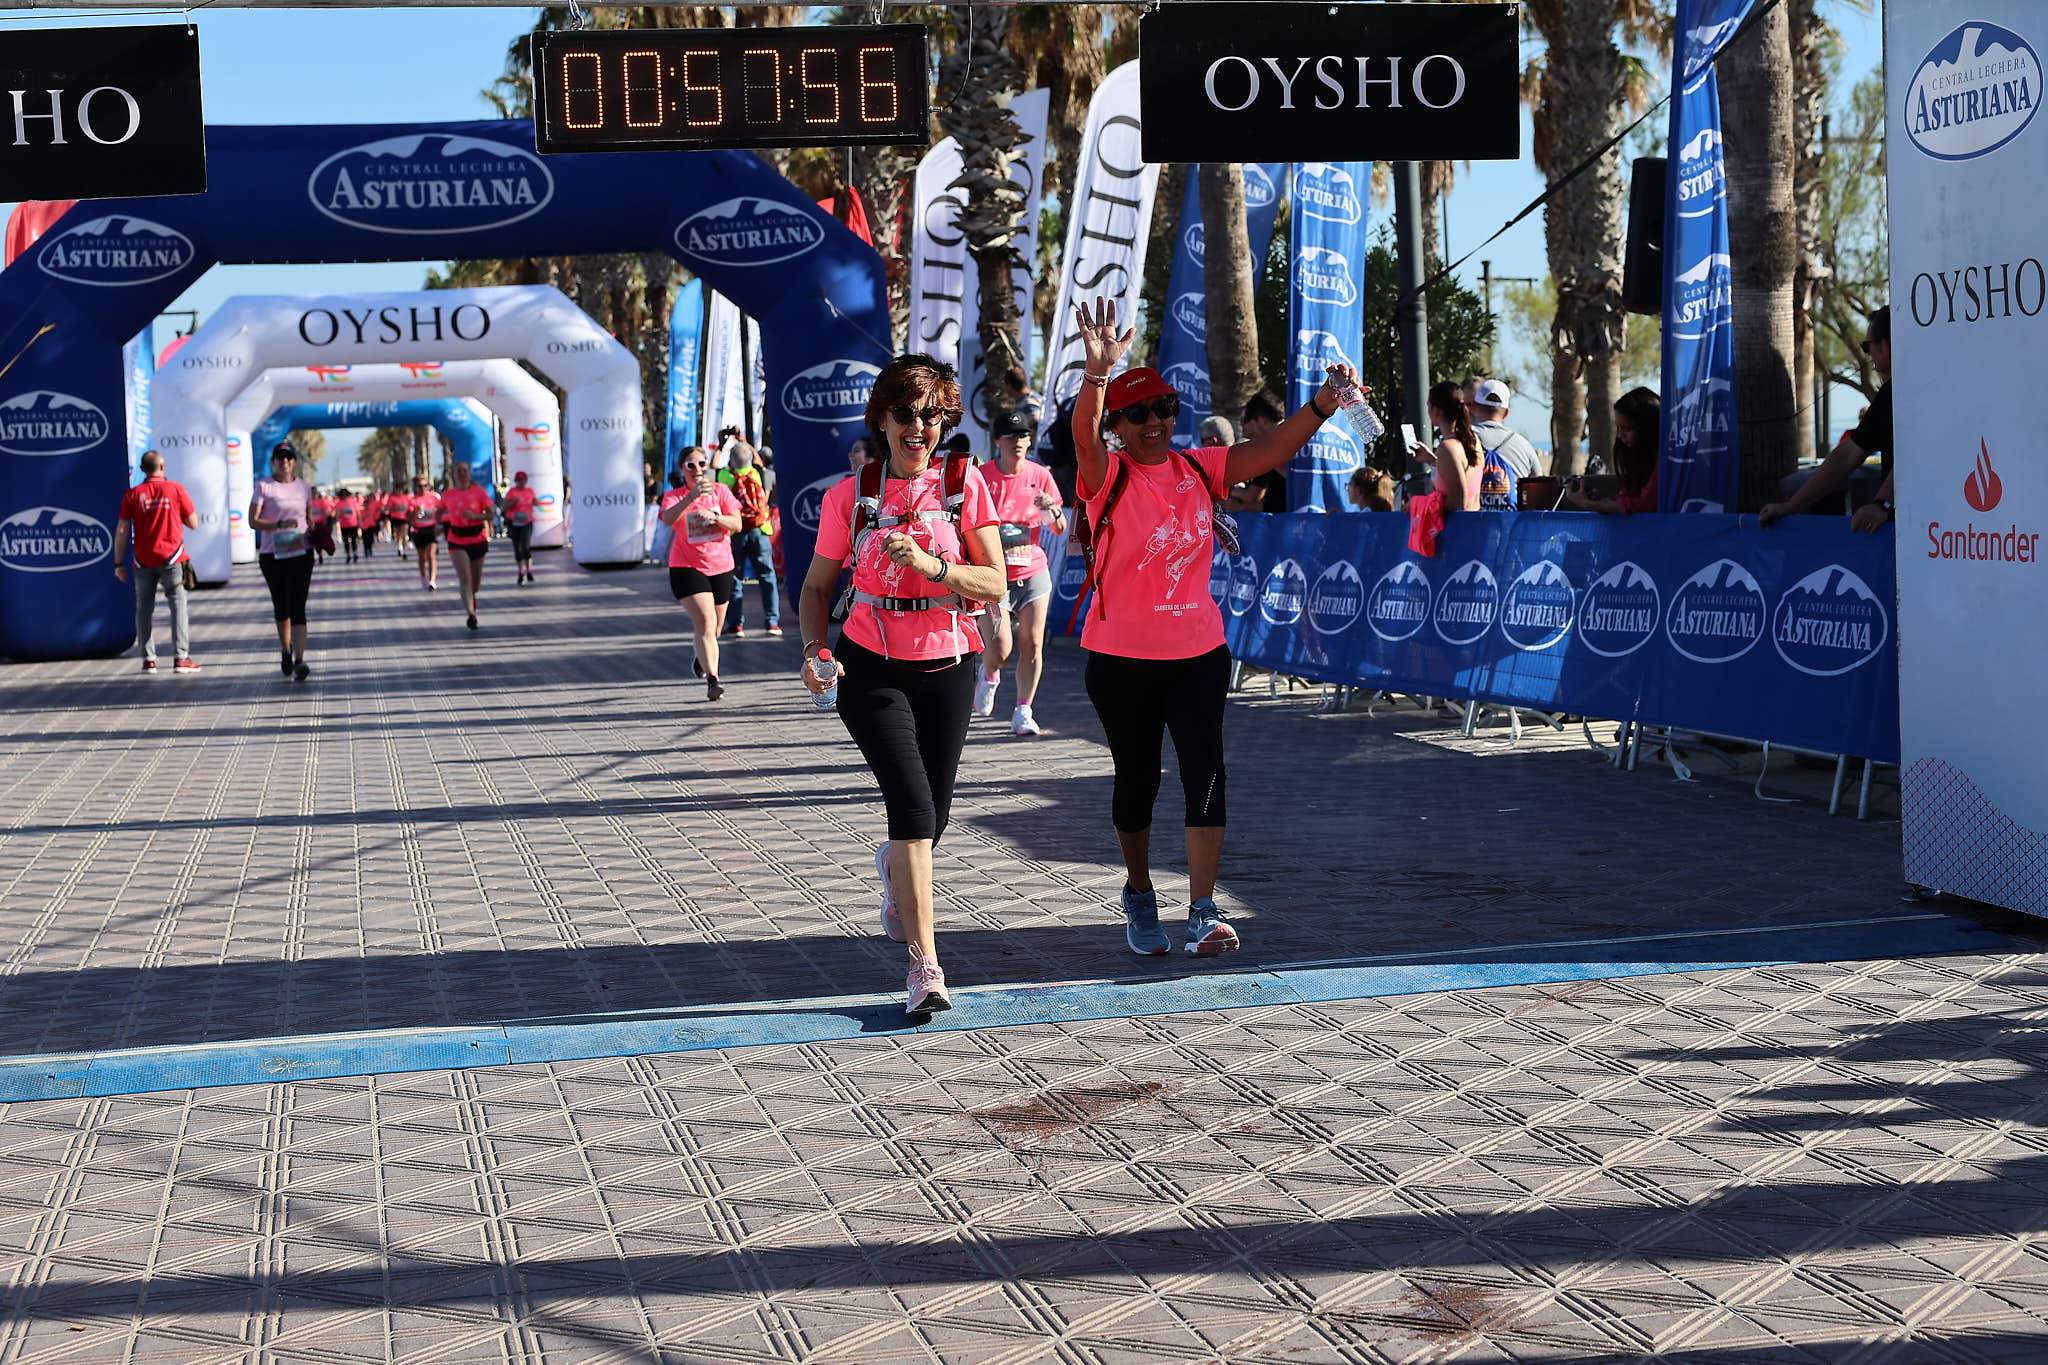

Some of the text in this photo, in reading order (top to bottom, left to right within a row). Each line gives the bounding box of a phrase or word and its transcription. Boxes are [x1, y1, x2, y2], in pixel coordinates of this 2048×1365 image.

[563, 47, 898, 129] 00:57:56
[1204, 54, 1466, 111] OYSHO
[1932, 57, 2026, 91] CENTRAL LECHERA
[1913, 76, 2032, 135] ASTURIANA
[365, 161, 527, 176] CENTRAL LECHERA
[328, 167, 536, 210] ASTURIANA
[47, 243, 182, 268] ASTURIANA
[688, 226, 815, 251] ASTURIANA
[1911, 258, 2046, 327] OYSHO
[298, 303, 490, 347] OYSHO
[183, 352, 242, 369] OYSHO
[546, 339, 605, 354] OYSHO
[160, 434, 216, 449] OYSHO
[580, 418, 633, 432] OYSHO
[583, 494, 636, 507] OYSHO
[1928, 521, 2040, 563] Santander
[1311, 586, 1357, 616] ASTURIANA
[1370, 590, 1425, 621] ASTURIANA
[1437, 591, 1492, 623] ASTURIANA
[1504, 591, 1567, 628] ASTURIANA
[1582, 596, 1651, 633] ASTURIANA
[1672, 597, 1756, 638] ASTURIANA
[1778, 602, 1872, 651] ASTURIANA
